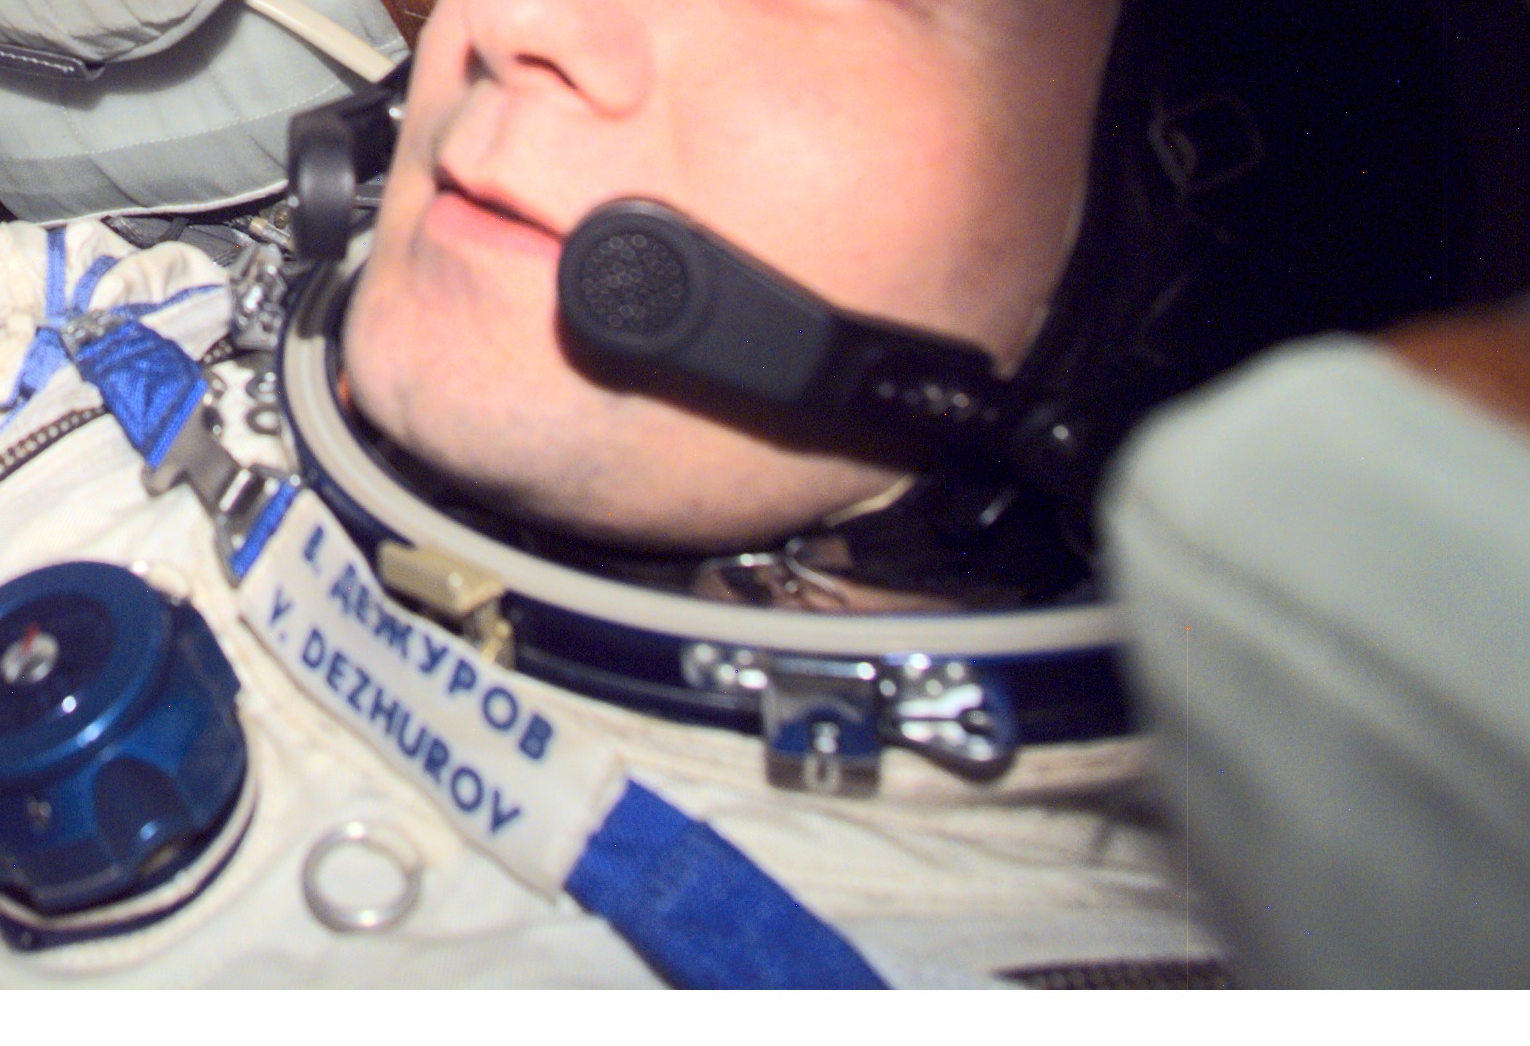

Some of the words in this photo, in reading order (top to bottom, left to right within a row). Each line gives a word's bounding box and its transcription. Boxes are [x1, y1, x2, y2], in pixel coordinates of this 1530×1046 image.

[269, 585, 293, 642] V.
[301, 628, 523, 834] DEZHUROV
[330, 563, 554, 760] ДЕЖУРОВ
